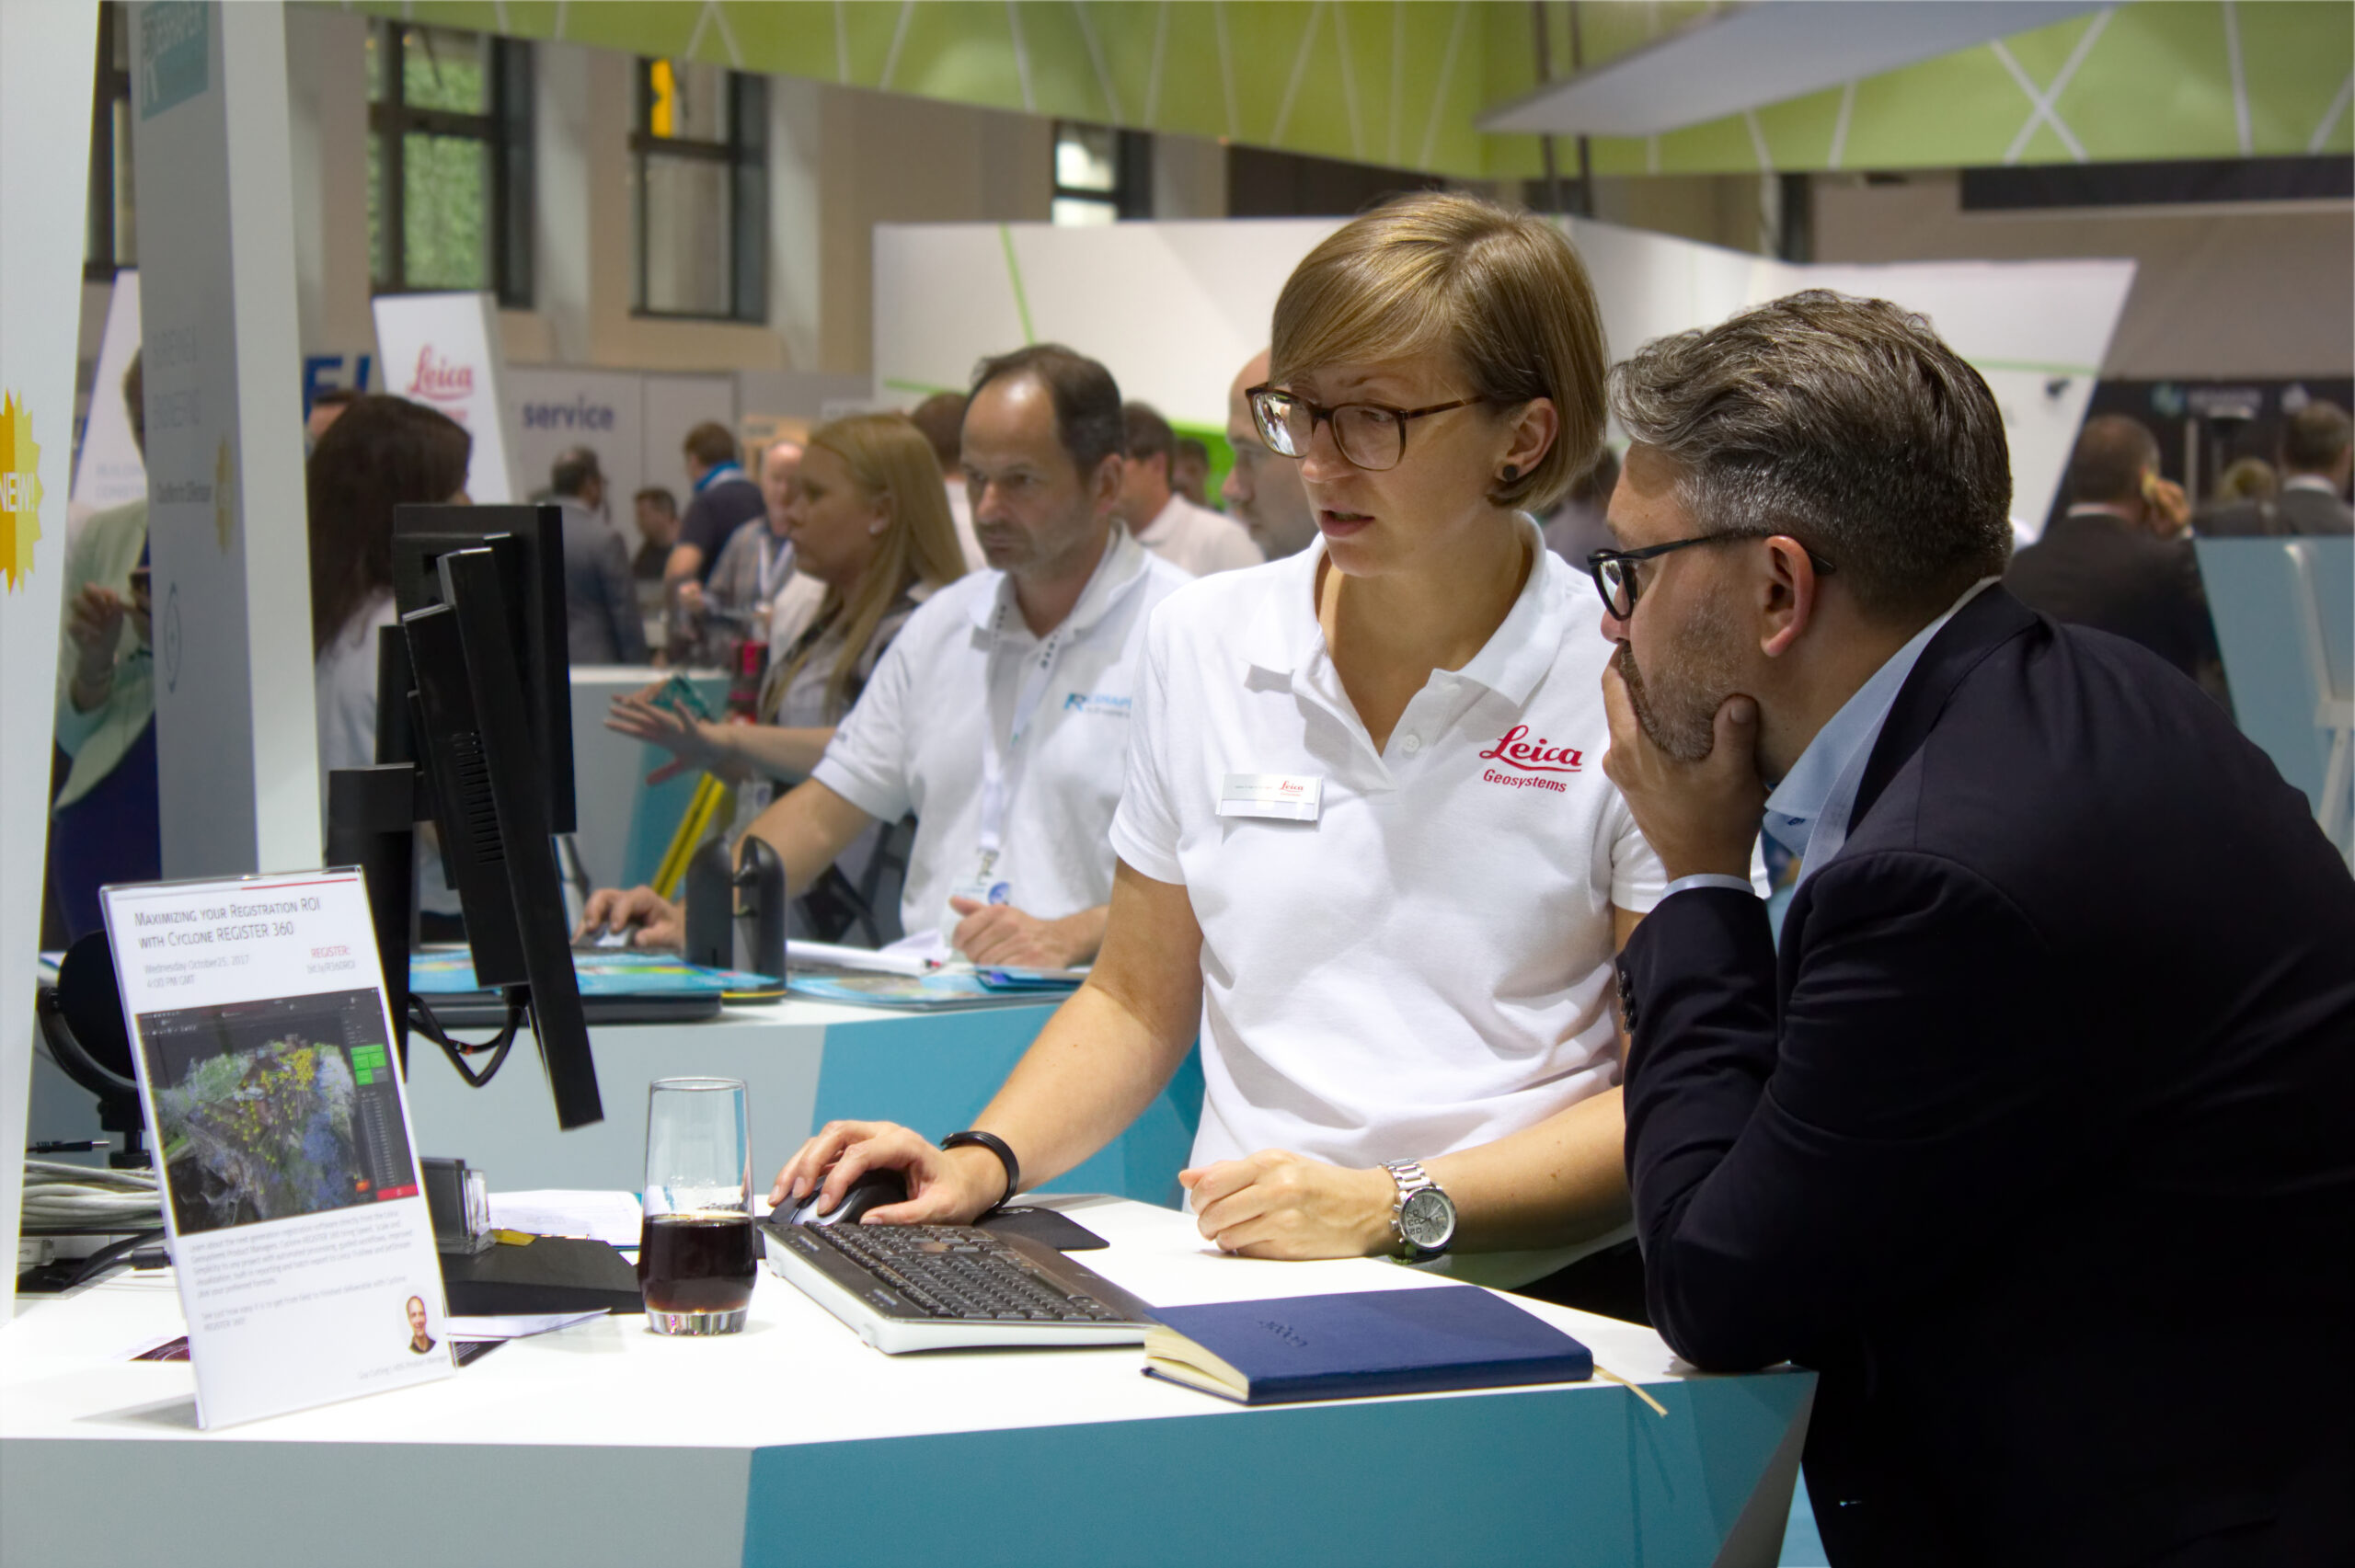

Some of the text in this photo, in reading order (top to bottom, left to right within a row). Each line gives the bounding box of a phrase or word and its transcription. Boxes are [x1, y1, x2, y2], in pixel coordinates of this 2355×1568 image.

[408, 344, 474, 400] Leica
[523, 395, 615, 429] service
[1479, 725, 1582, 773] Leica
[1279, 780, 1304, 793] Leica
[1483, 769, 1568, 794] Geosystems
[300, 897, 321, 911] ROI
[216, 923, 270, 942] REGISTER
[271, 921, 294, 936] 360
